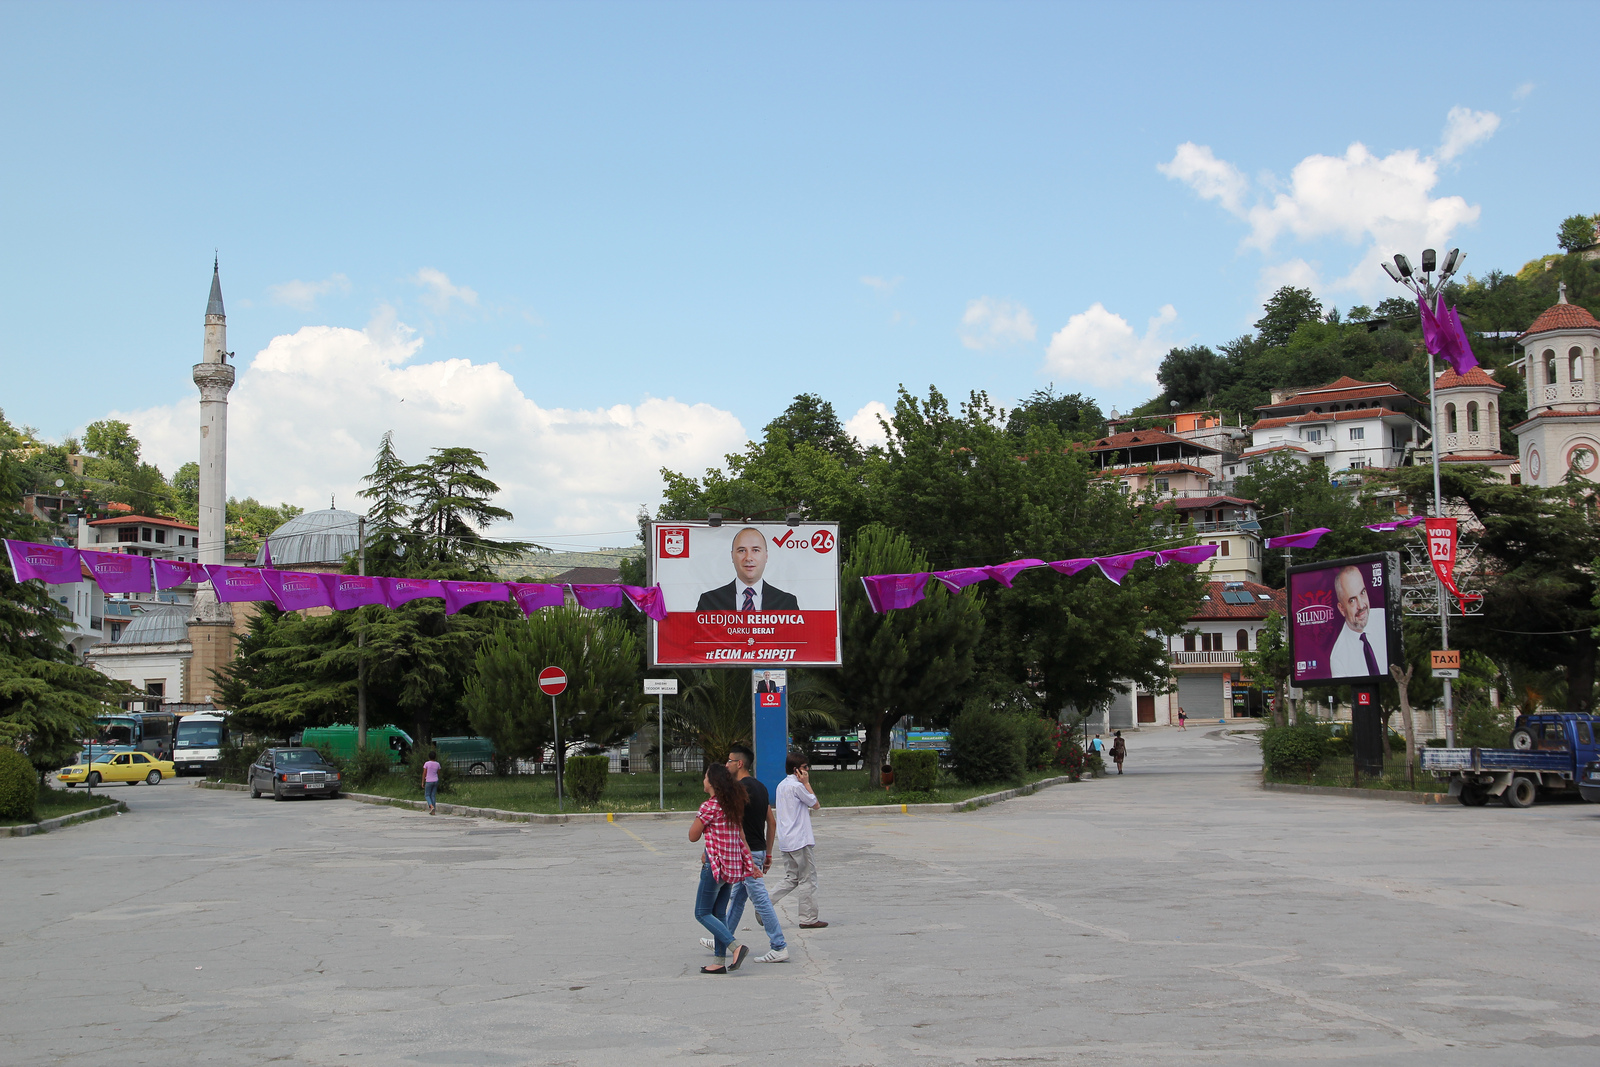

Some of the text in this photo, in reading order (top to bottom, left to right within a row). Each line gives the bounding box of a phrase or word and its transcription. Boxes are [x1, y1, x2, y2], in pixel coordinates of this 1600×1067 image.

[1429, 528, 1451, 537] VOTO
[813, 532, 834, 549] 26
[1433, 543, 1448, 556] 26
[1372, 576, 1383, 587] 29
[697, 613, 805, 626] GLEDJON REHOVICA
[1296, 609, 1335, 623] RILINDJE
[727, 627, 775, 635] QARKU BERAT
[705, 649, 797, 661] TË ECIM MË SHPEJT
[1433, 655, 1459, 664] TAXI
